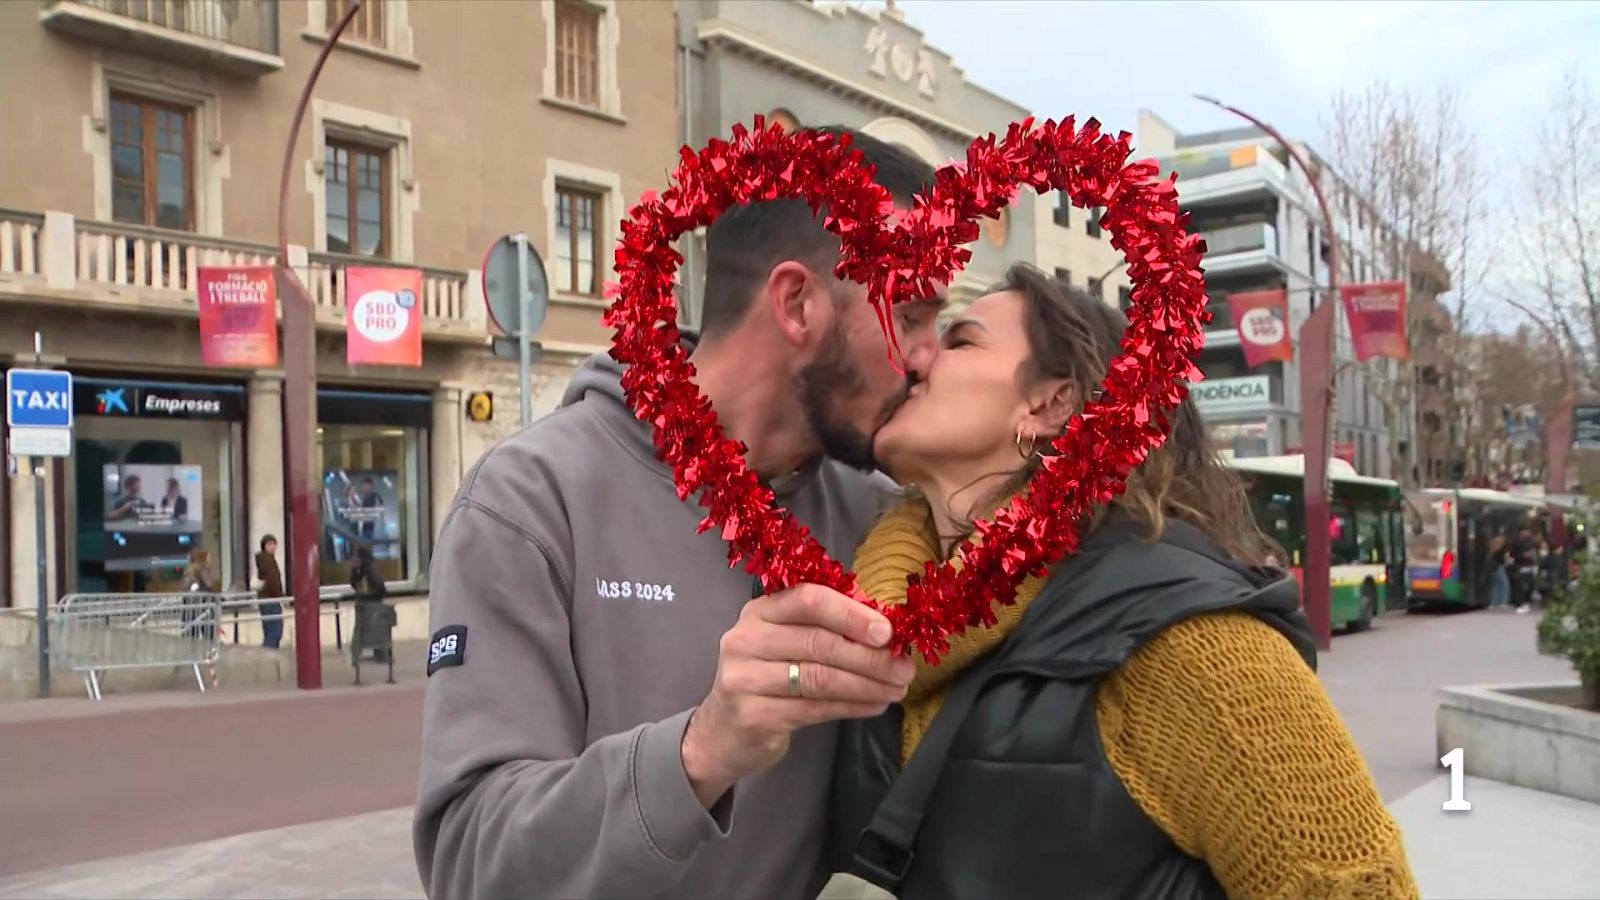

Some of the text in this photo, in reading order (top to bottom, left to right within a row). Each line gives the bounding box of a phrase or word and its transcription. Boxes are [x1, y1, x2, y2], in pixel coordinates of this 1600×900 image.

[208, 279, 268, 293] FORMACIÓ
[217, 291, 266, 304] TREBALL
[366, 302, 396, 314] SBD
[366, 316, 396, 329] PRO
[12, 390, 67, 410] TAXI
[145, 394, 221, 413] Empreses
[635, 582, 675, 601] 2024
[431, 634, 458, 660] SPG
